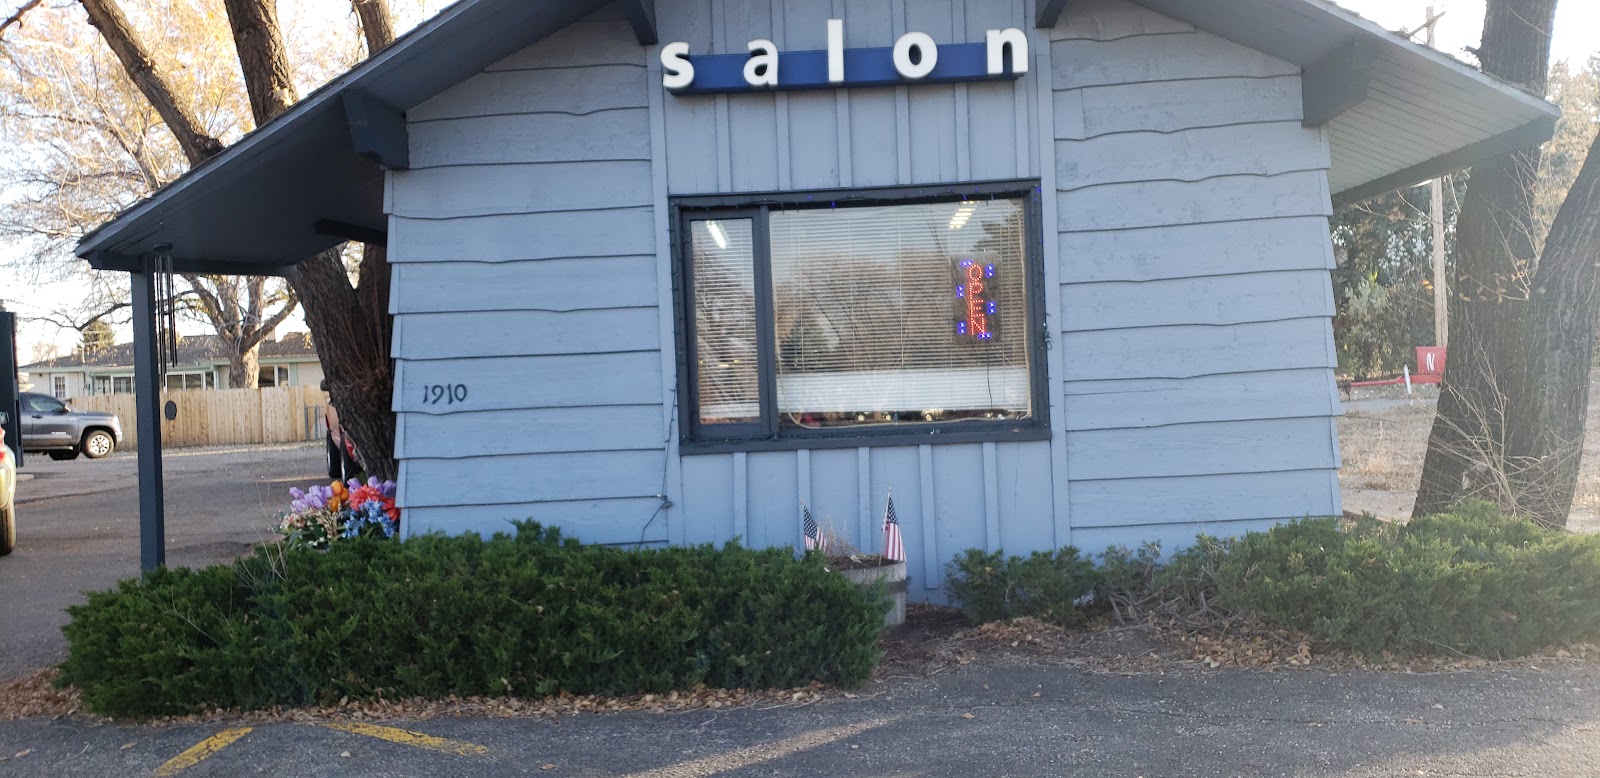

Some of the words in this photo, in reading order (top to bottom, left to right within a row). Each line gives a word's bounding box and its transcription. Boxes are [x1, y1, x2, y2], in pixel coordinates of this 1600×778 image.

[660, 18, 1029, 89] salon
[968, 264, 985, 335] OPEN
[1426, 352, 1435, 371] N
[422, 383, 467, 405] 1910
